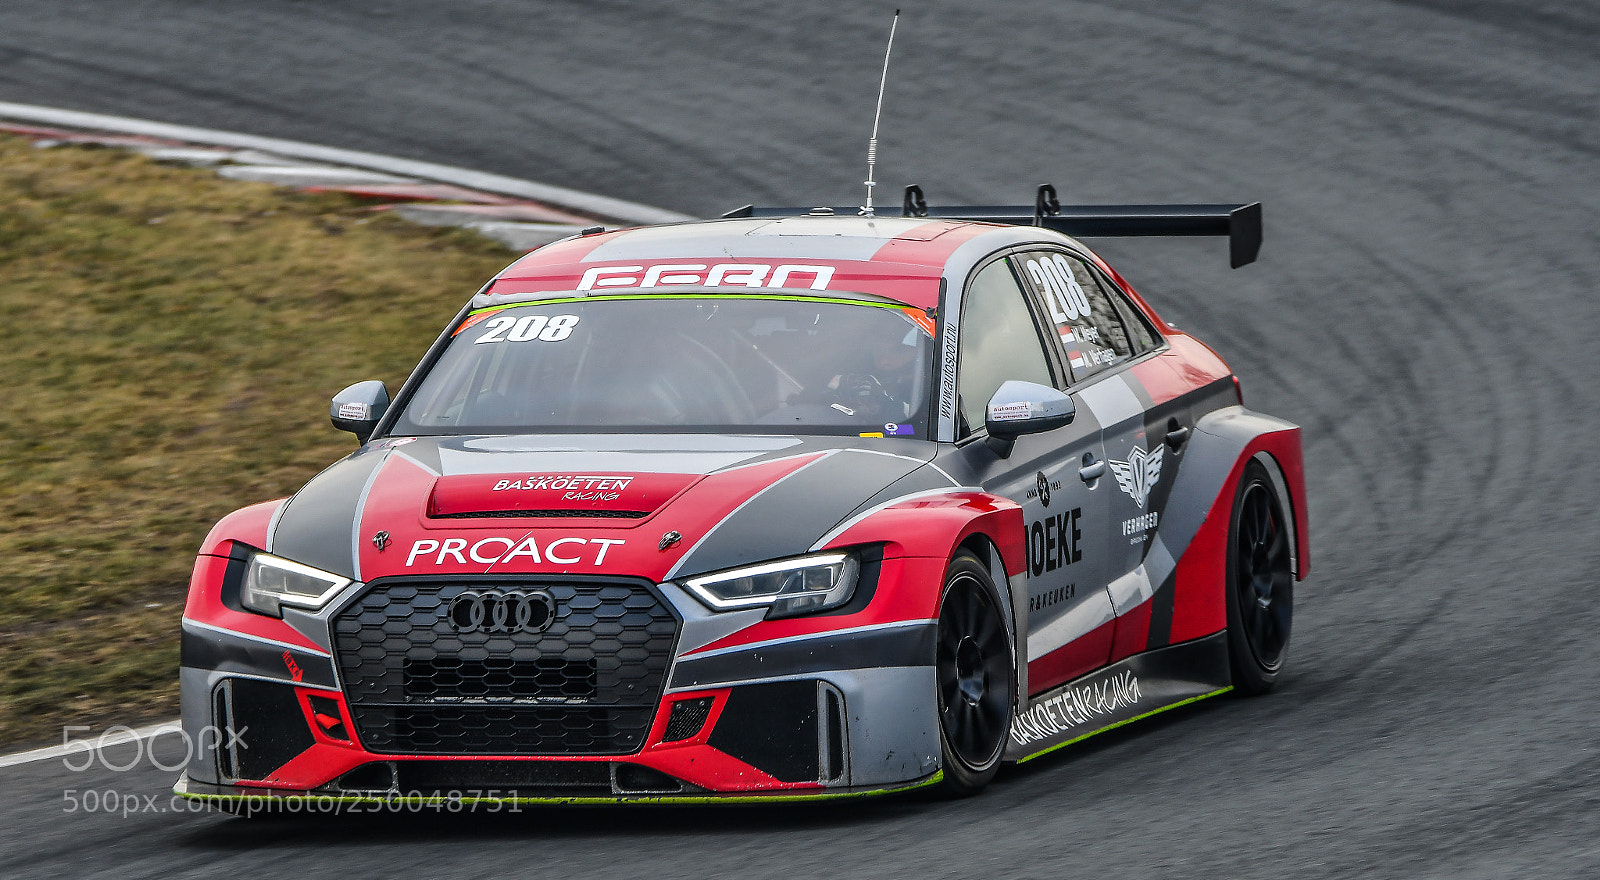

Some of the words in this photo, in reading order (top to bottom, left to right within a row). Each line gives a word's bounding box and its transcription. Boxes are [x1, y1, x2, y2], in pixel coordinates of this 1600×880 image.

[1027, 253, 1091, 324] 208
[474, 315, 580, 344] 208
[941, 322, 957, 420] www.autosport.nu
[493, 477, 633, 491] BASKOETEN
[561, 491, 621, 501] RACING
